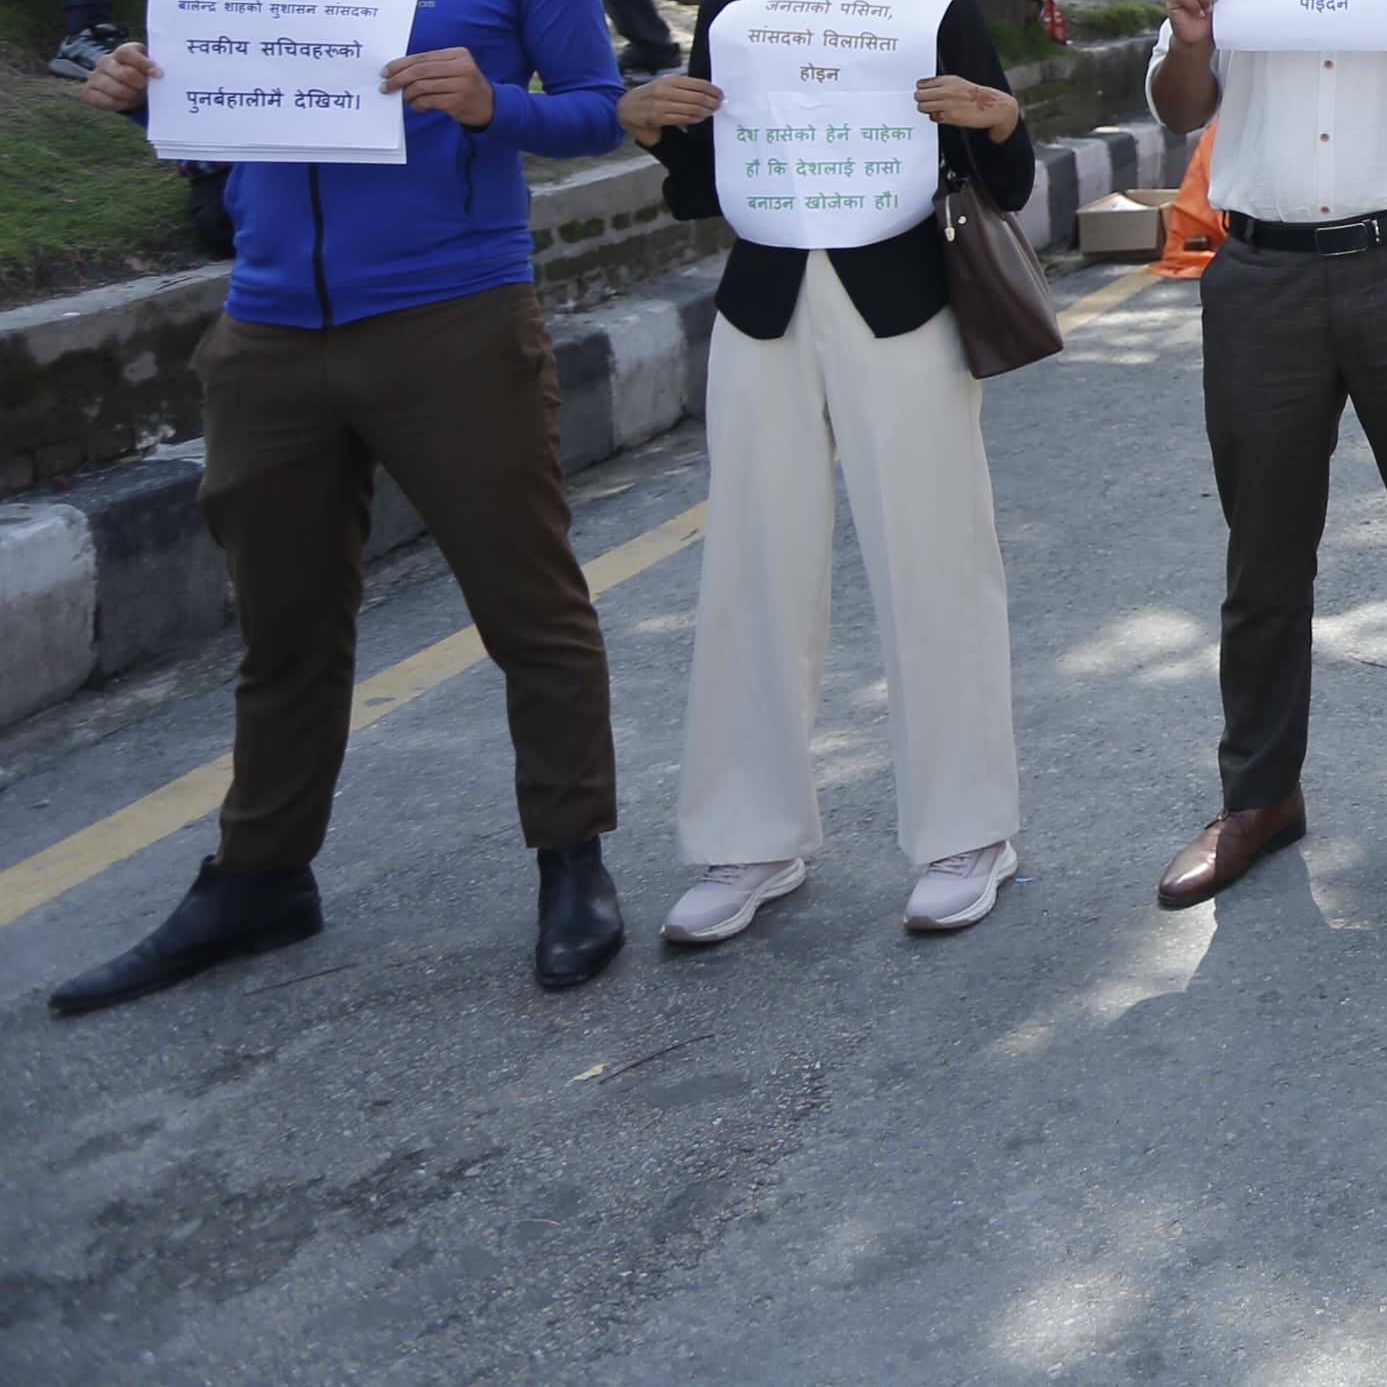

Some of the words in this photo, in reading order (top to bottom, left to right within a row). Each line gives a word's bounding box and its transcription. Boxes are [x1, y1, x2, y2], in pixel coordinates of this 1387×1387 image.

[224, 0, 263, 14] शाहको
[269, 3, 318, 19] सुशासन
[324, 2, 379, 17] सांसदका
[840, 0, 893, 20] पसिना,
[186, 36, 250, 55] स्वकीय
[260, 37, 363, 60] सचिवहरूको
[748, 25, 814, 46] सांसदको
[823, 29, 899, 51] विलासिता
[800, 63, 841, 83] होइन
[186, 87, 284, 113] पुनर्बहालीमै
[736, 124, 760, 142] देश
[766, 124, 817, 144] हासेको
[826, 123, 852, 144] हेर्न
[860, 124, 914, 142] चाहेका
[767, 158, 788, 175] कि
[796, 157, 856, 178] देशलाई
[864, 157, 902, 177] हासो
[747, 197, 796, 210] बनाउन
[804, 192, 865, 209] खोजेका
